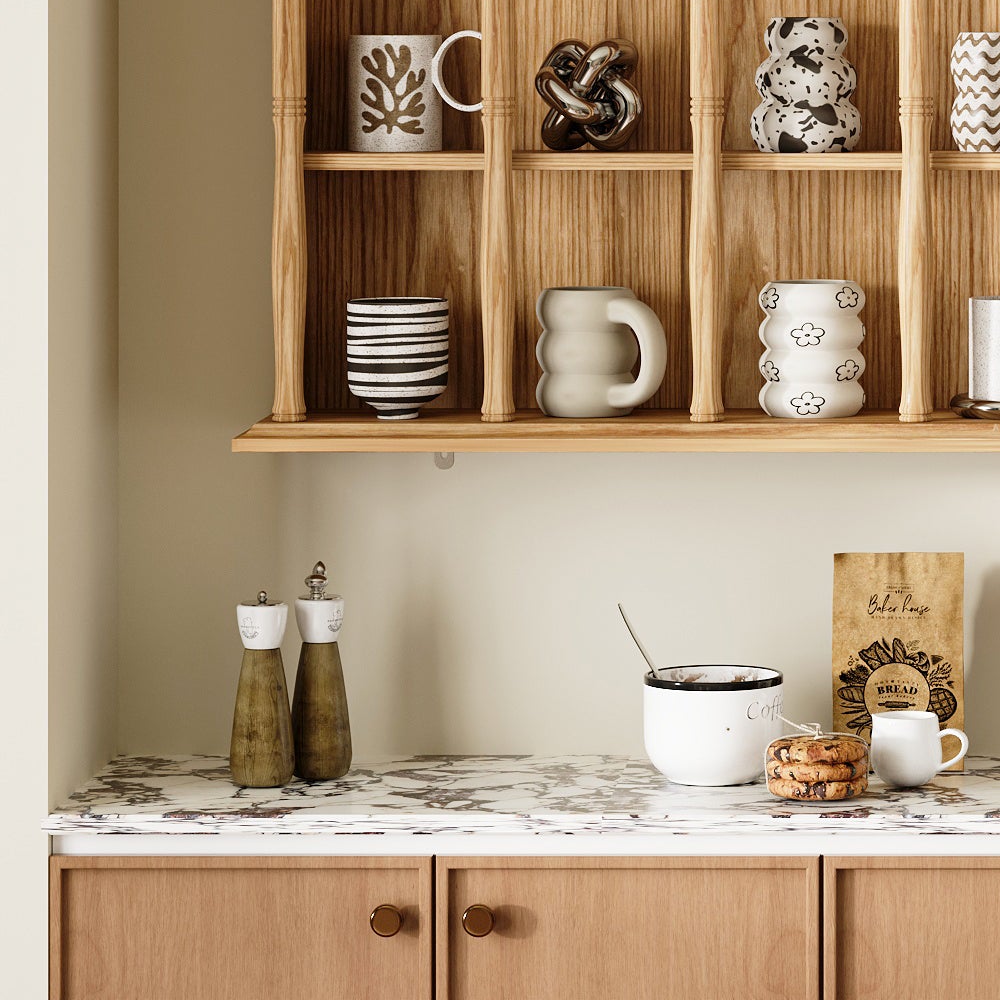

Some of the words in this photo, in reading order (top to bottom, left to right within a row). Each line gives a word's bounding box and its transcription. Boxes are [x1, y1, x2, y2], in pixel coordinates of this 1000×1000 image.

[867, 593, 898, 615] Baker
[901, 593, 931, 615] house
[876, 684, 918, 695] BREAD
